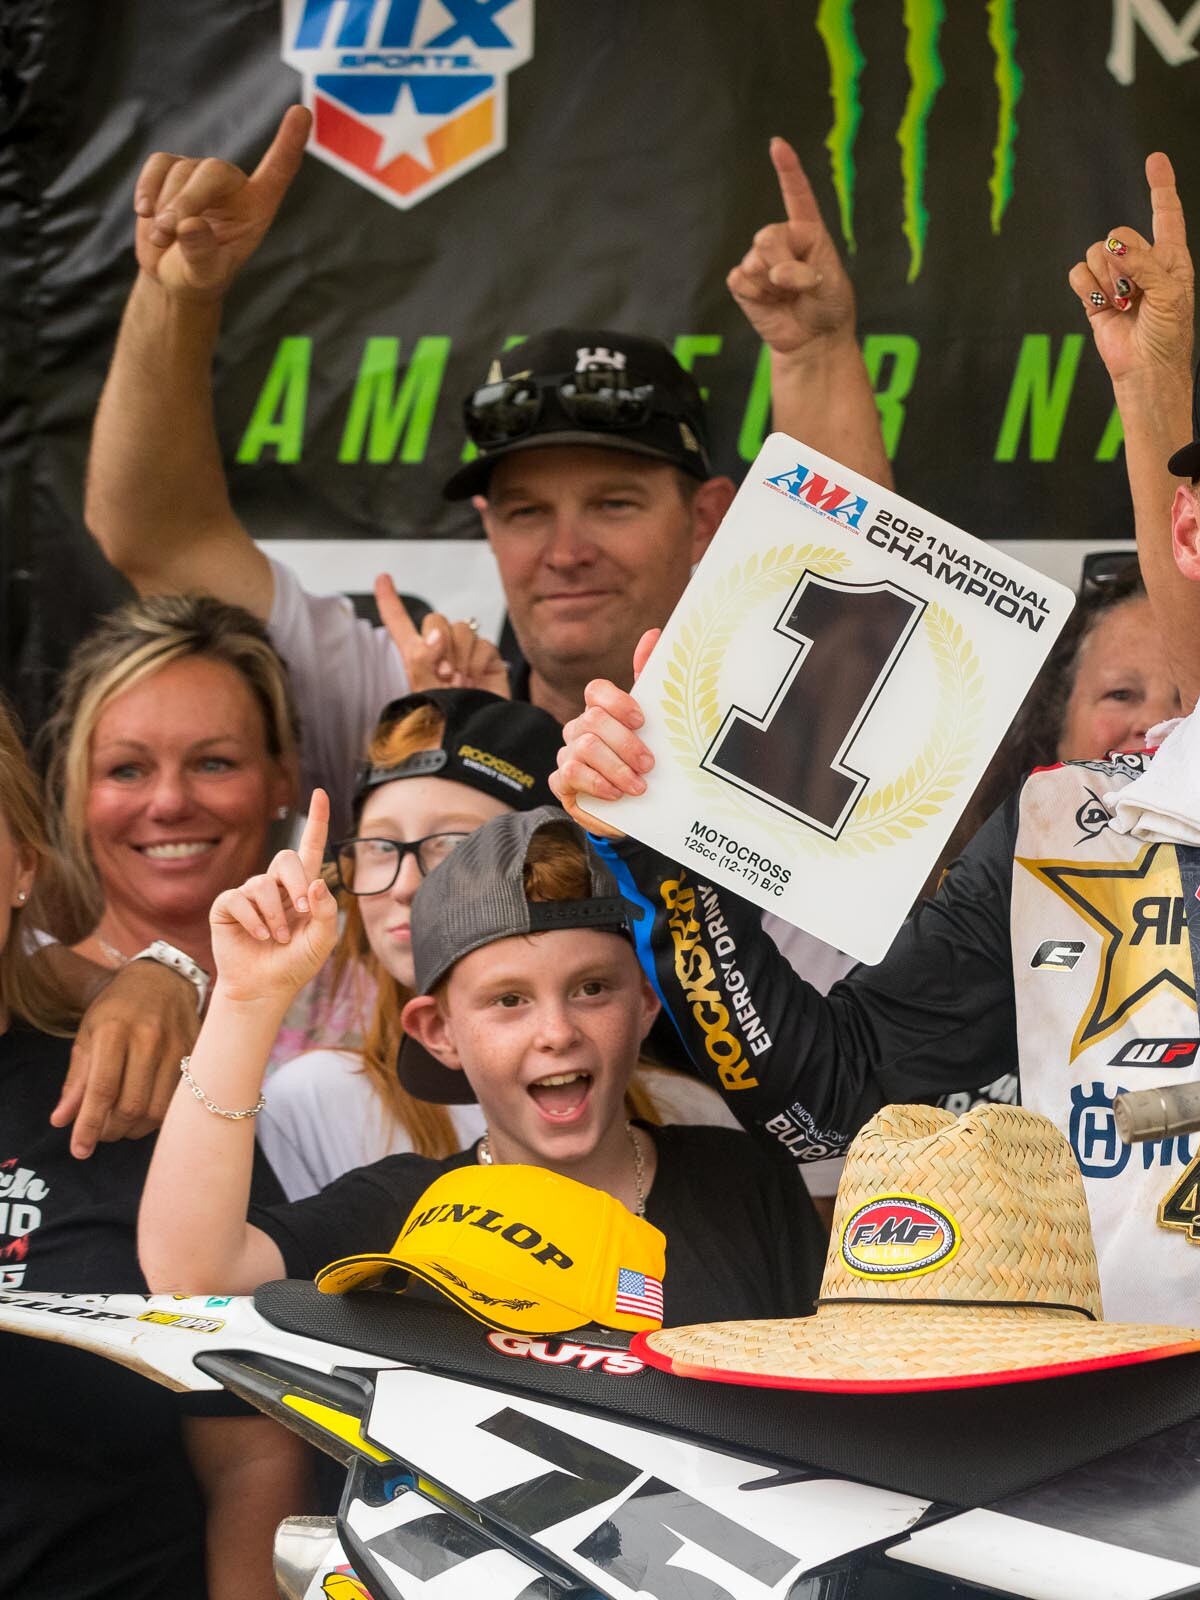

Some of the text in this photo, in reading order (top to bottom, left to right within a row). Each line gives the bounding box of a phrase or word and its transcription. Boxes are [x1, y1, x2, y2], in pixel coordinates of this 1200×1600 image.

[762, 480, 860, 537] AMERICAN MOTORCYCLIST ASSOCIATION
[766, 463, 869, 530] AMA
[866, 525, 1046, 633] CHAMPION
[875, 509, 1050, 614] 2021 NATIONAL
[700, 568, 930, 842] 1
[684, 836, 785, 897] 125cc (12-17) B/C
[690, 820, 792, 883] MOTOCROSS
[720, 959, 773, 1057] ENERGY
[1122, 1042, 1197, 1064] WP
[400, 1203, 574, 1270] DUNLOP
[849, 1216, 941, 1248] FMF
[488, 1332, 646, 1375] GUTS
